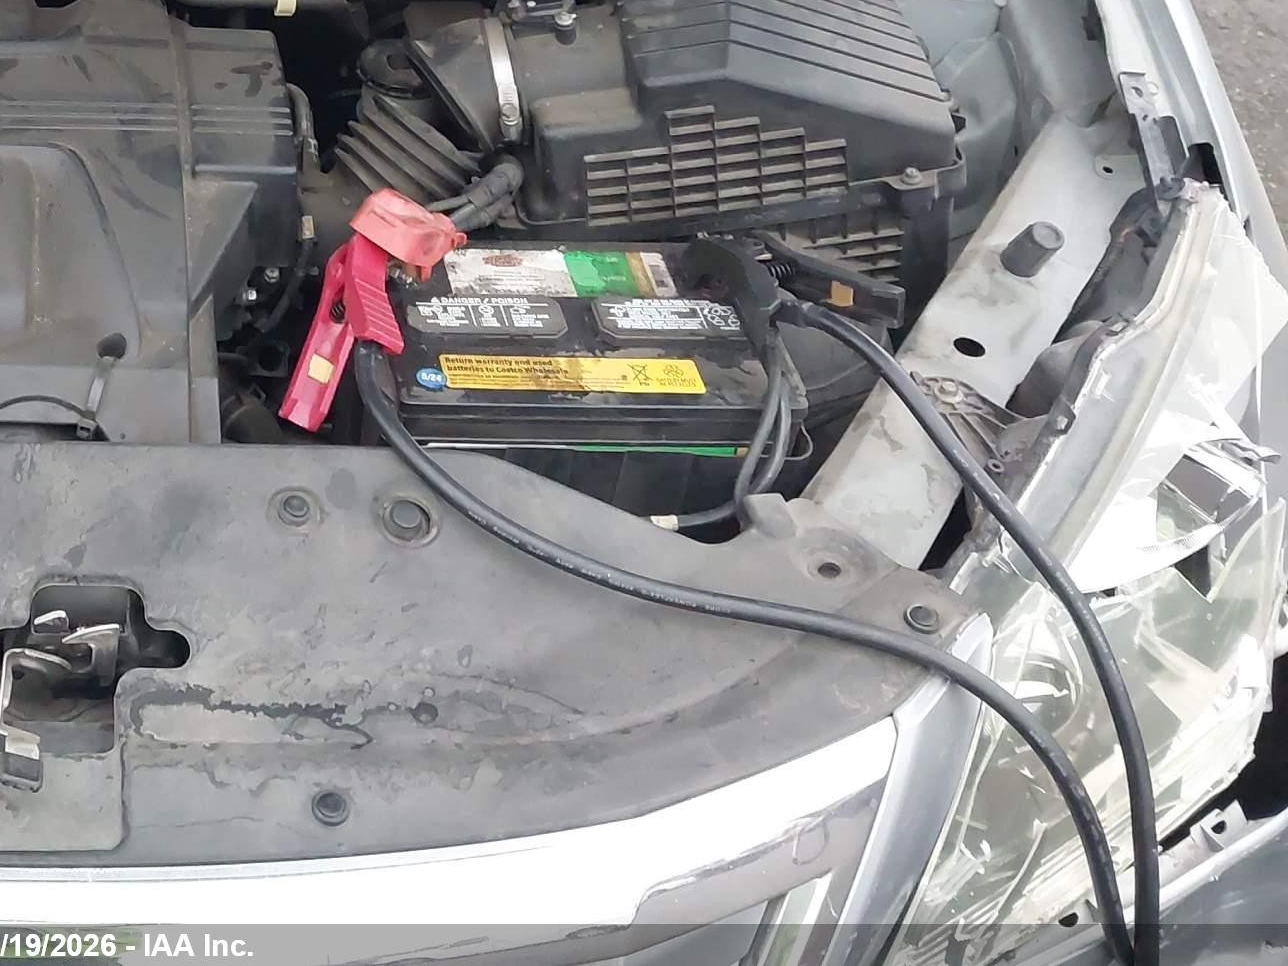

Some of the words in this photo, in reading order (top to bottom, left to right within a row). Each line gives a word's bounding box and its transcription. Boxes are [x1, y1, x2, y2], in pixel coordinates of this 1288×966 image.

[444, 356, 473, 364] Return
[475, 358, 513, 367] warranty
[446, 365, 485, 373] batteries
[485, 365, 495, 373] to
[496, 366, 524, 374] Costco
[524, 366, 569, 375] Wholesale
